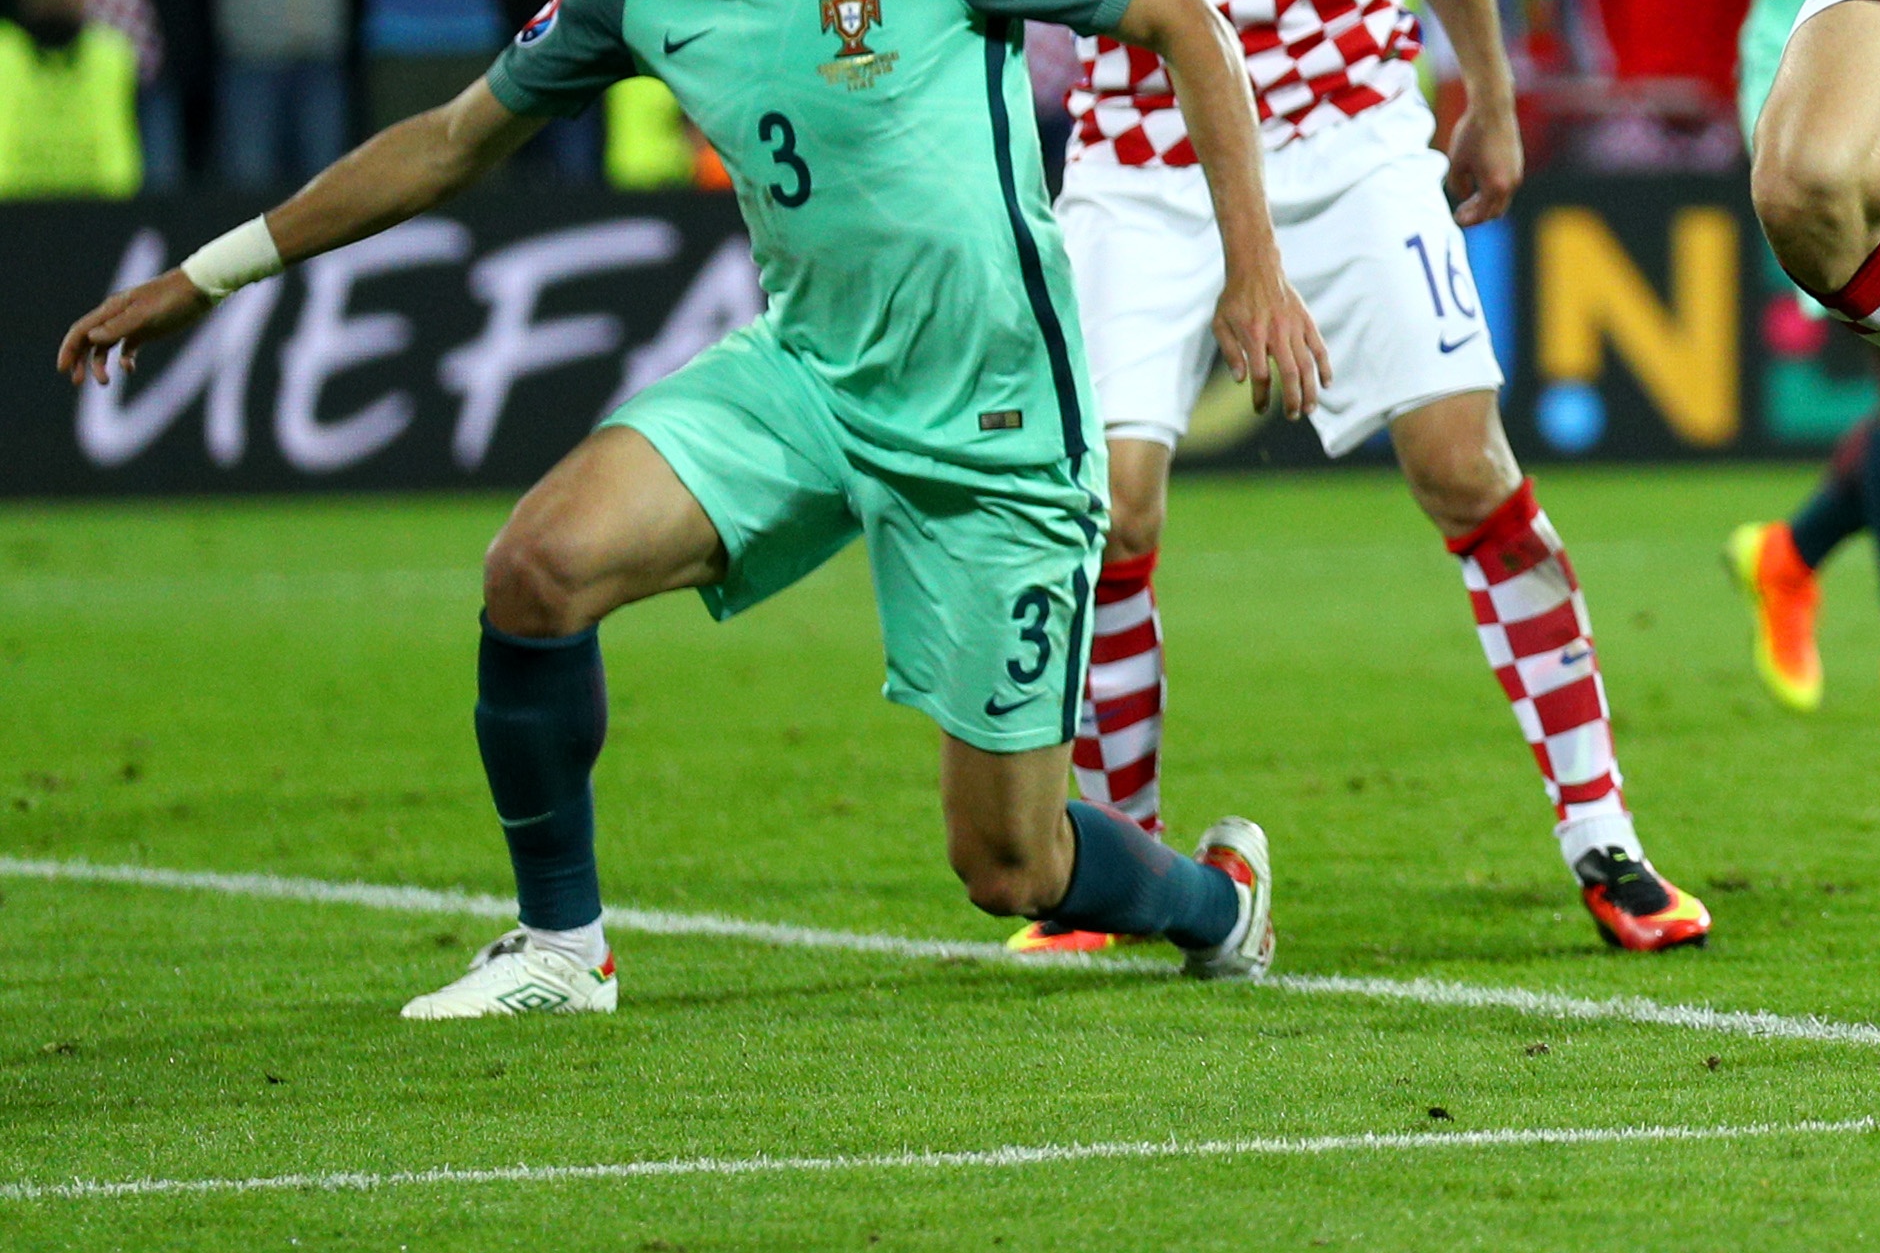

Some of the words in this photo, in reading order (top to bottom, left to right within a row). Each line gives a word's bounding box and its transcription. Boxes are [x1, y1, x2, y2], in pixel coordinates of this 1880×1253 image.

[757, 111, 812, 208] 3
[1404, 233, 1476, 319] 16
[1006, 584, 1052, 684] 3
